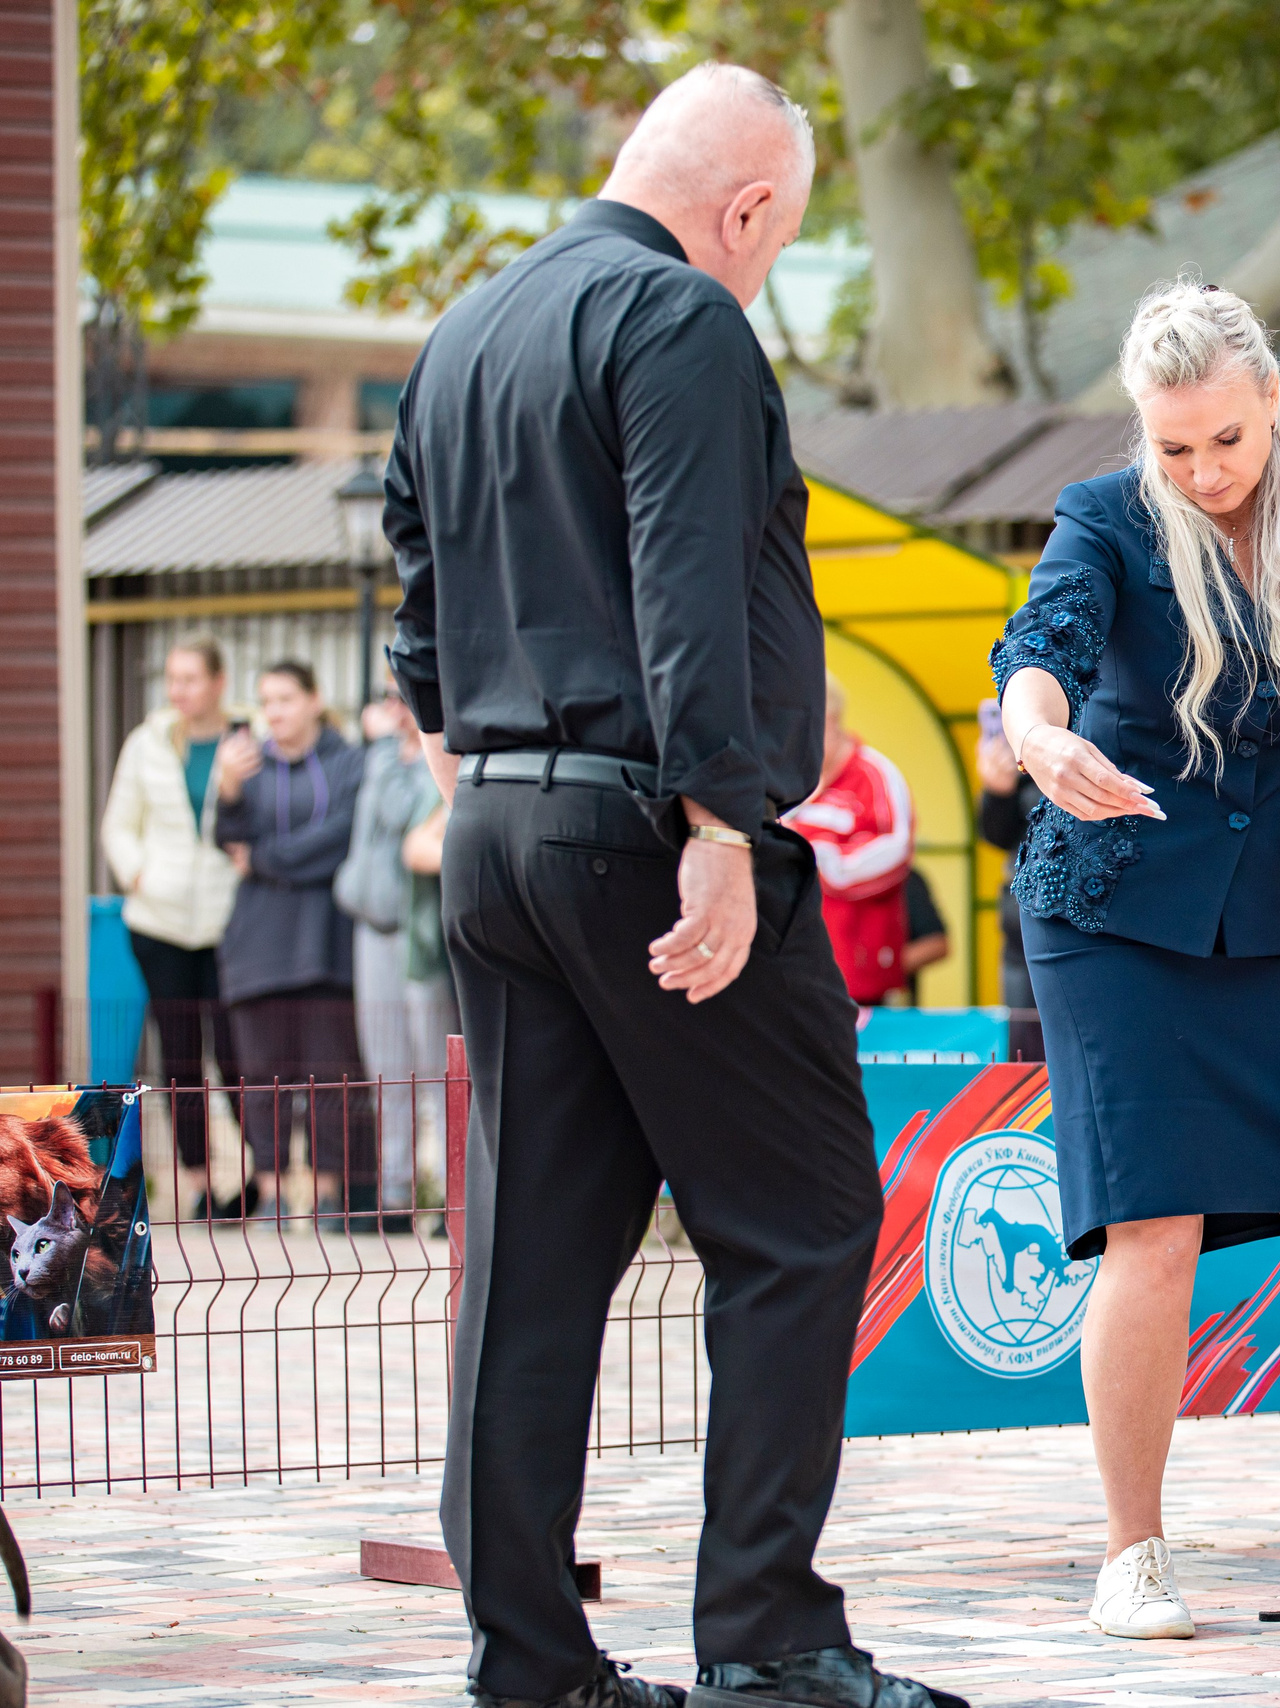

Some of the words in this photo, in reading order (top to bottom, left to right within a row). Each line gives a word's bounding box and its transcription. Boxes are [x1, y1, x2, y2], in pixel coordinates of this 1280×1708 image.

[16, 1355, 28, 1365] 60
[30, 1354, 43, 1364] 89
[70, 1351, 131, 1362] delo-korm.ru
